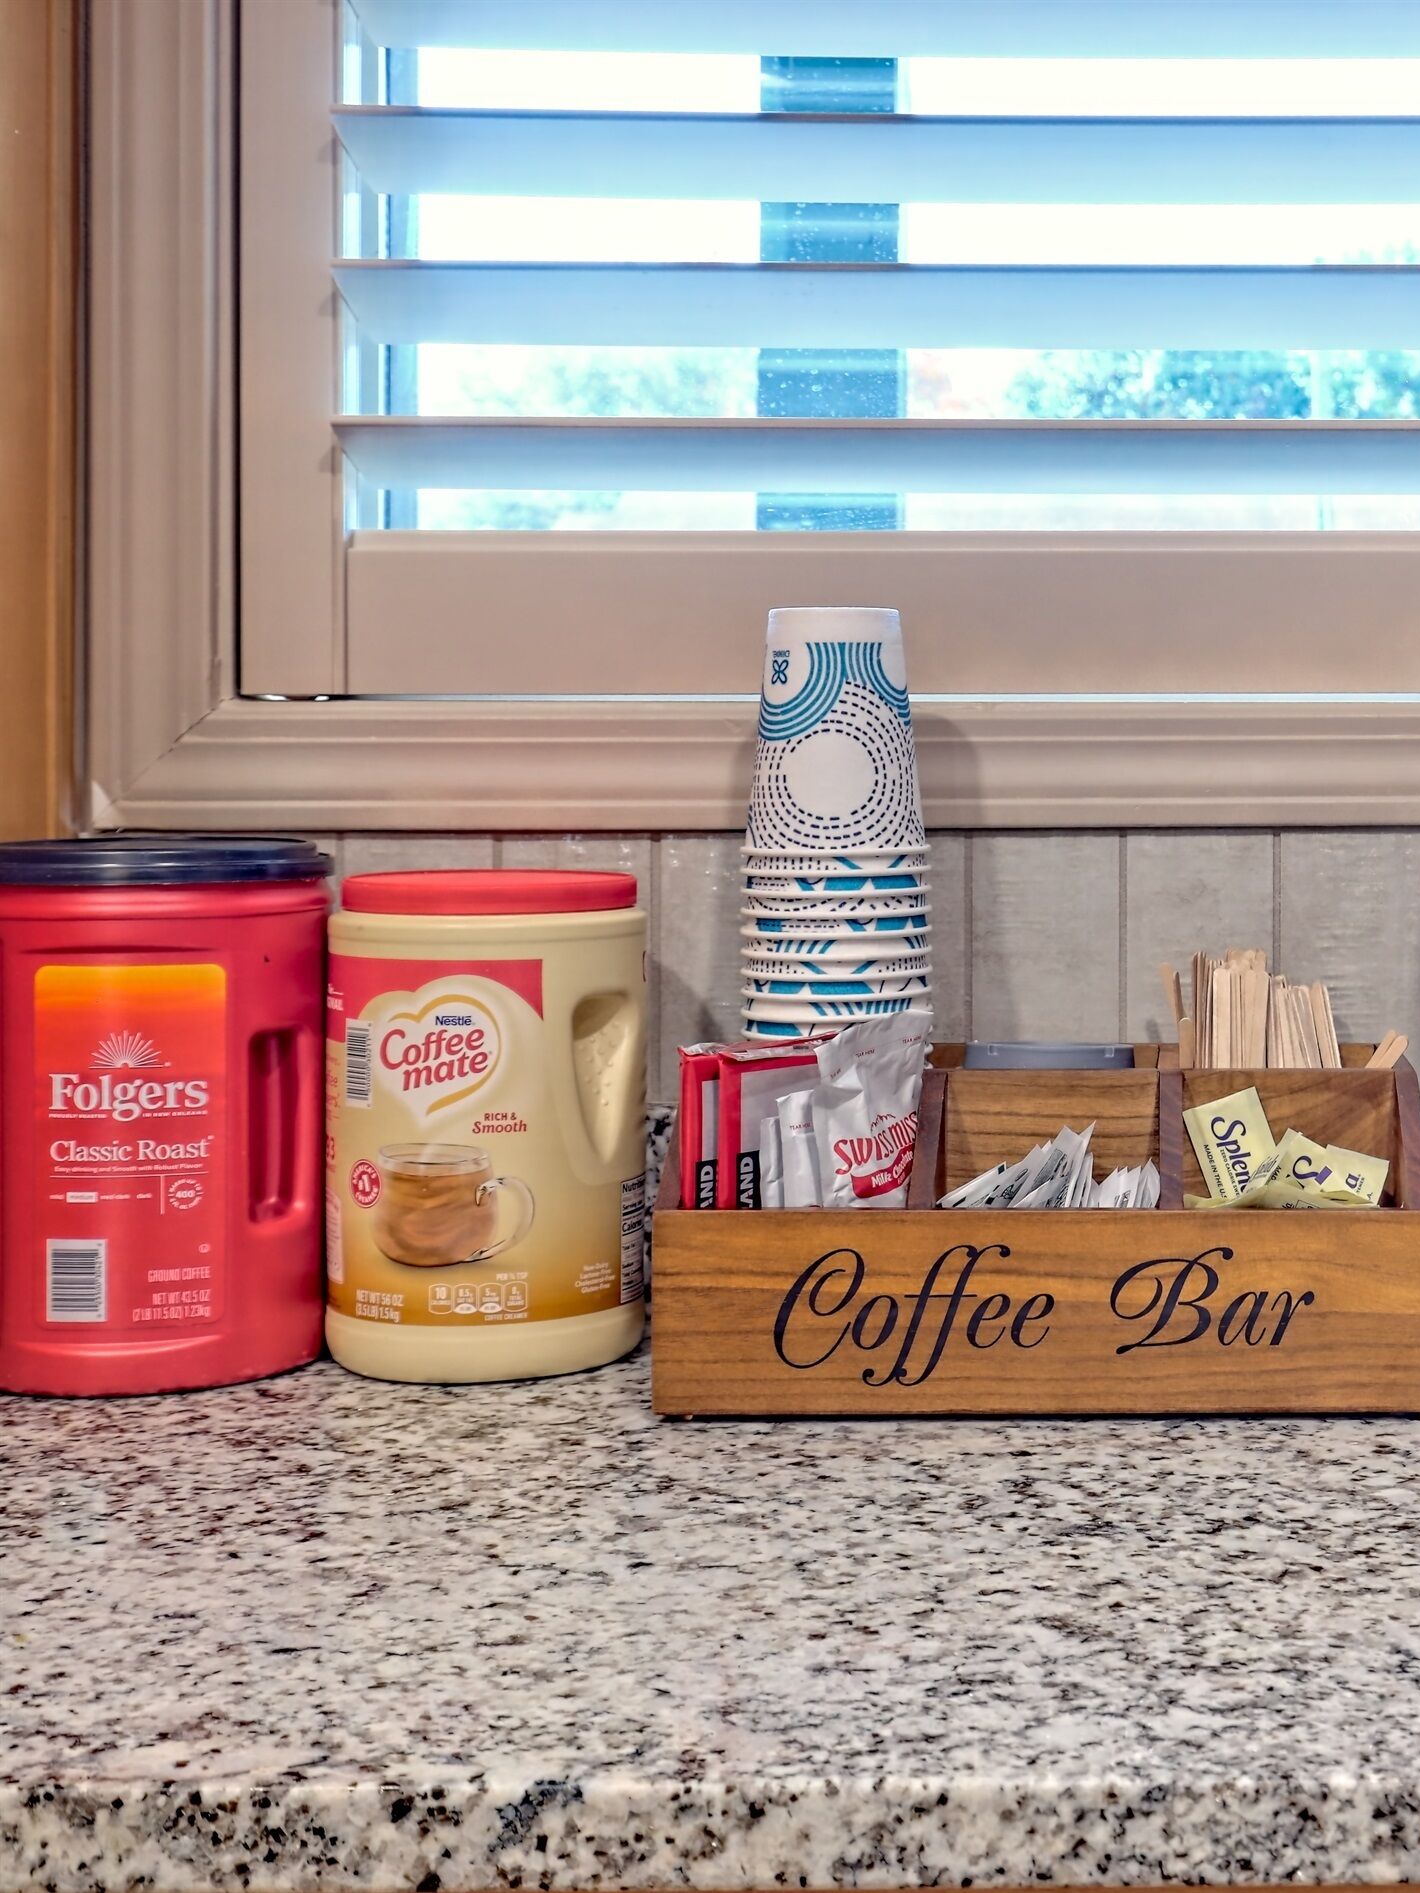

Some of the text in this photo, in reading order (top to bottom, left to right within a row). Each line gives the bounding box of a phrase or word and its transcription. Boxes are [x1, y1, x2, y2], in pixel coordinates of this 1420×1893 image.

[379, 1028, 485, 1070] Coffee
[402, 1051, 489, 1092] mate
[48, 1073, 210, 1122] Folgers
[472, 1119, 527, 1134] Smooth
[483, 1111, 517, 1122] RICH &
[49, 1138, 210, 1162] Classic Roast
[833, 1110, 919, 1175] SWISS MISS
[153, 1163, 178, 1171] Robust
[871, 1150, 914, 1188] Milk Chocolate
[1201, 1144, 1224, 1188] MADE IN THE
[1219, 1148, 1237, 1184] ZERO CALORIE
[147, 1266, 212, 1283] GROUND COFFEE
[152, 1288, 212, 1305] NET WT 43.5 OZ
[356, 1288, 369, 1303] NET
[381, 1292, 391, 1306] 56
[392, 1294, 405, 1307] OZ
[434, 1286, 448, 1300] 10
[772, 1243, 1056, 1387] Coffee
[1110, 1245, 1316, 1355] Bar
